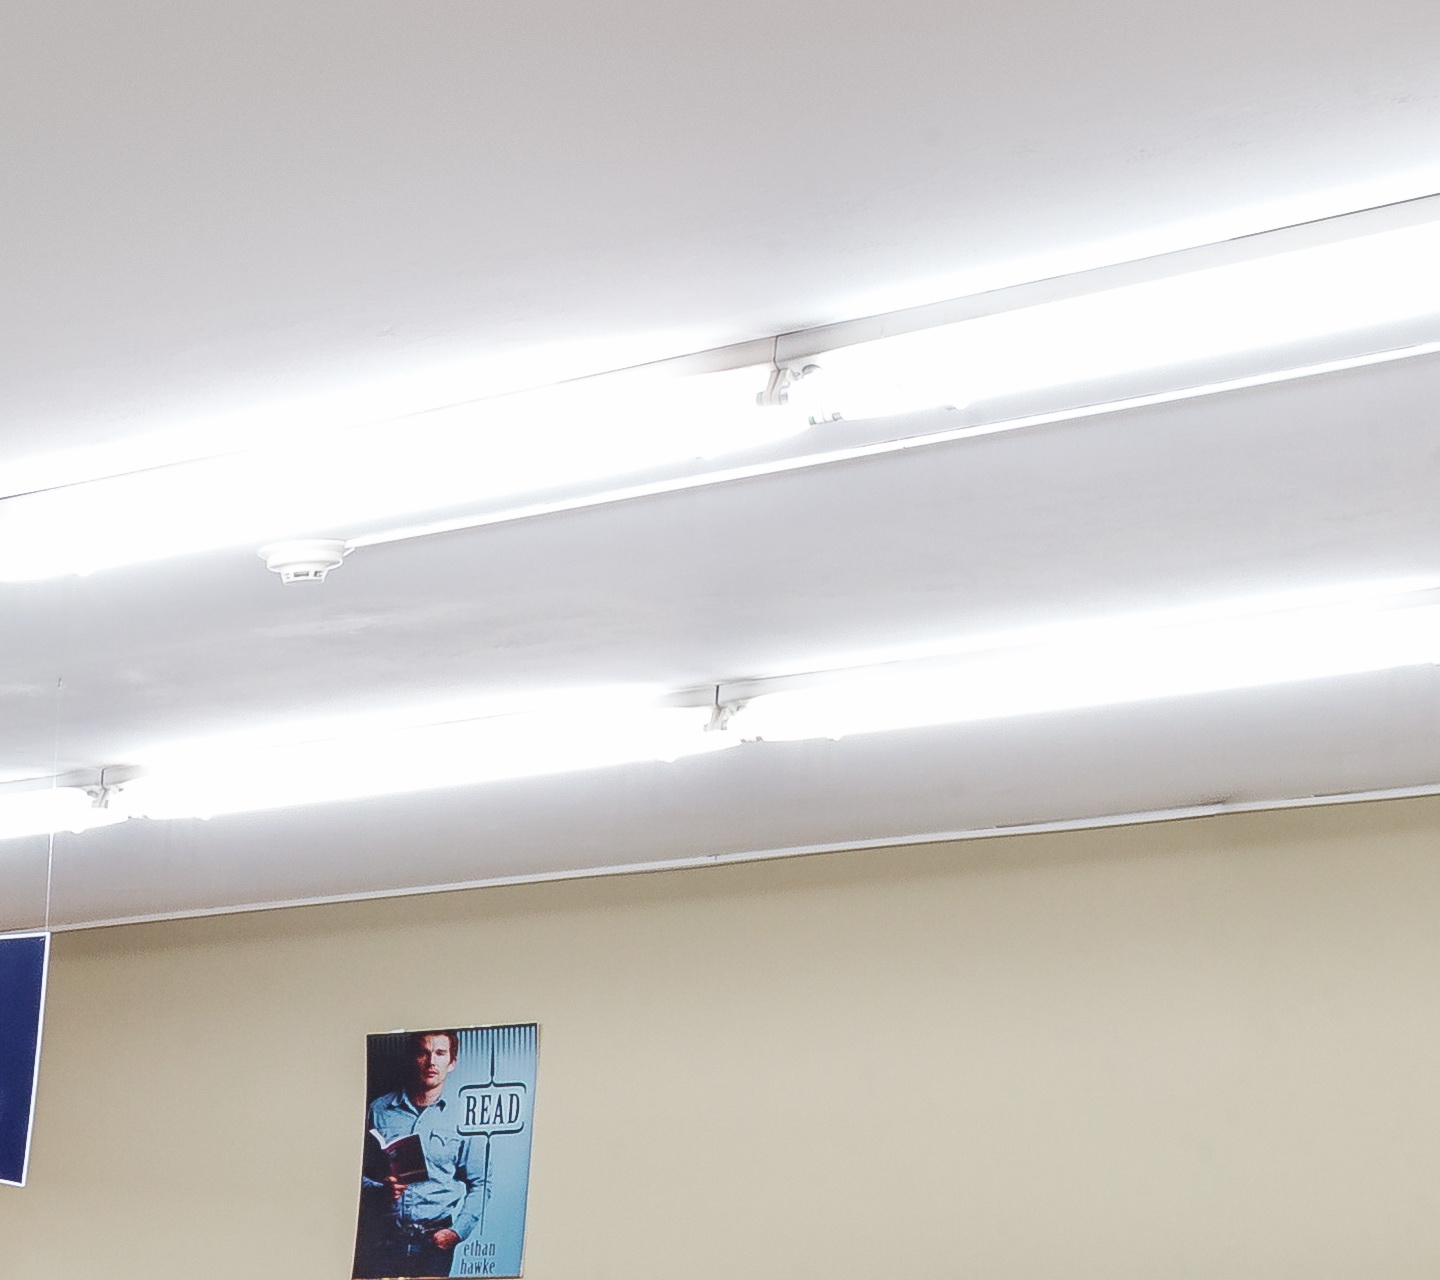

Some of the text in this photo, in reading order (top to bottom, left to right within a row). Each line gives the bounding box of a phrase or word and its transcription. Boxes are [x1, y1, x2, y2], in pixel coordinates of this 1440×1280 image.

[464, 1093, 520, 1127] READ
[464, 1240, 496, 1256] ethan
[460, 1258, 495, 1276] hawke
